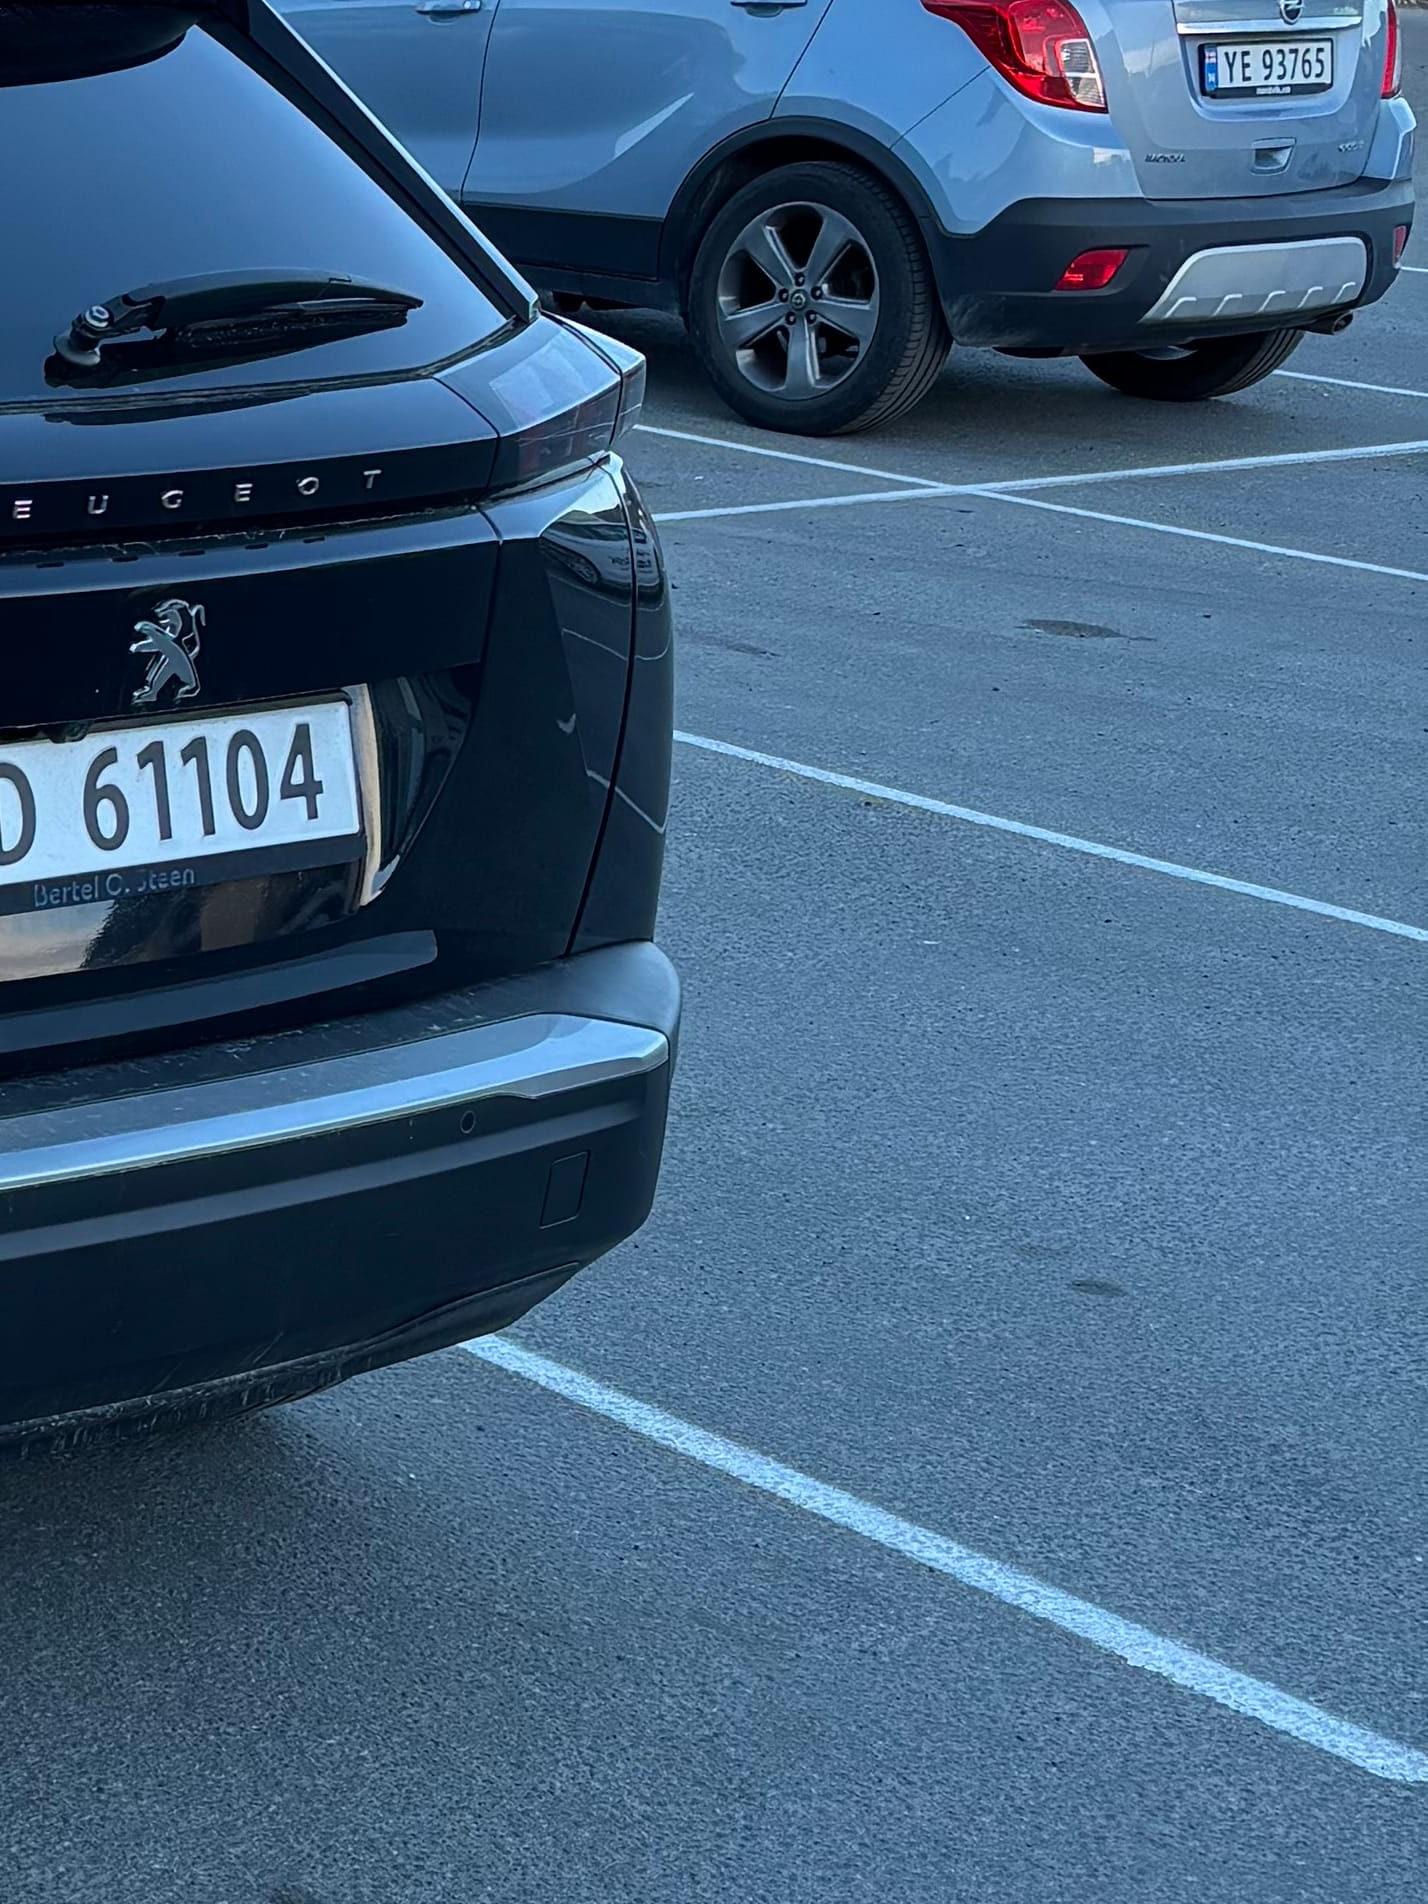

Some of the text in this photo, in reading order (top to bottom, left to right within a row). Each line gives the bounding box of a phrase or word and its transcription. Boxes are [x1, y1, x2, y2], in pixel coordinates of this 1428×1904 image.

[1224, 47, 1326, 83] YE 93765
[82, 722, 324, 851] 61104
